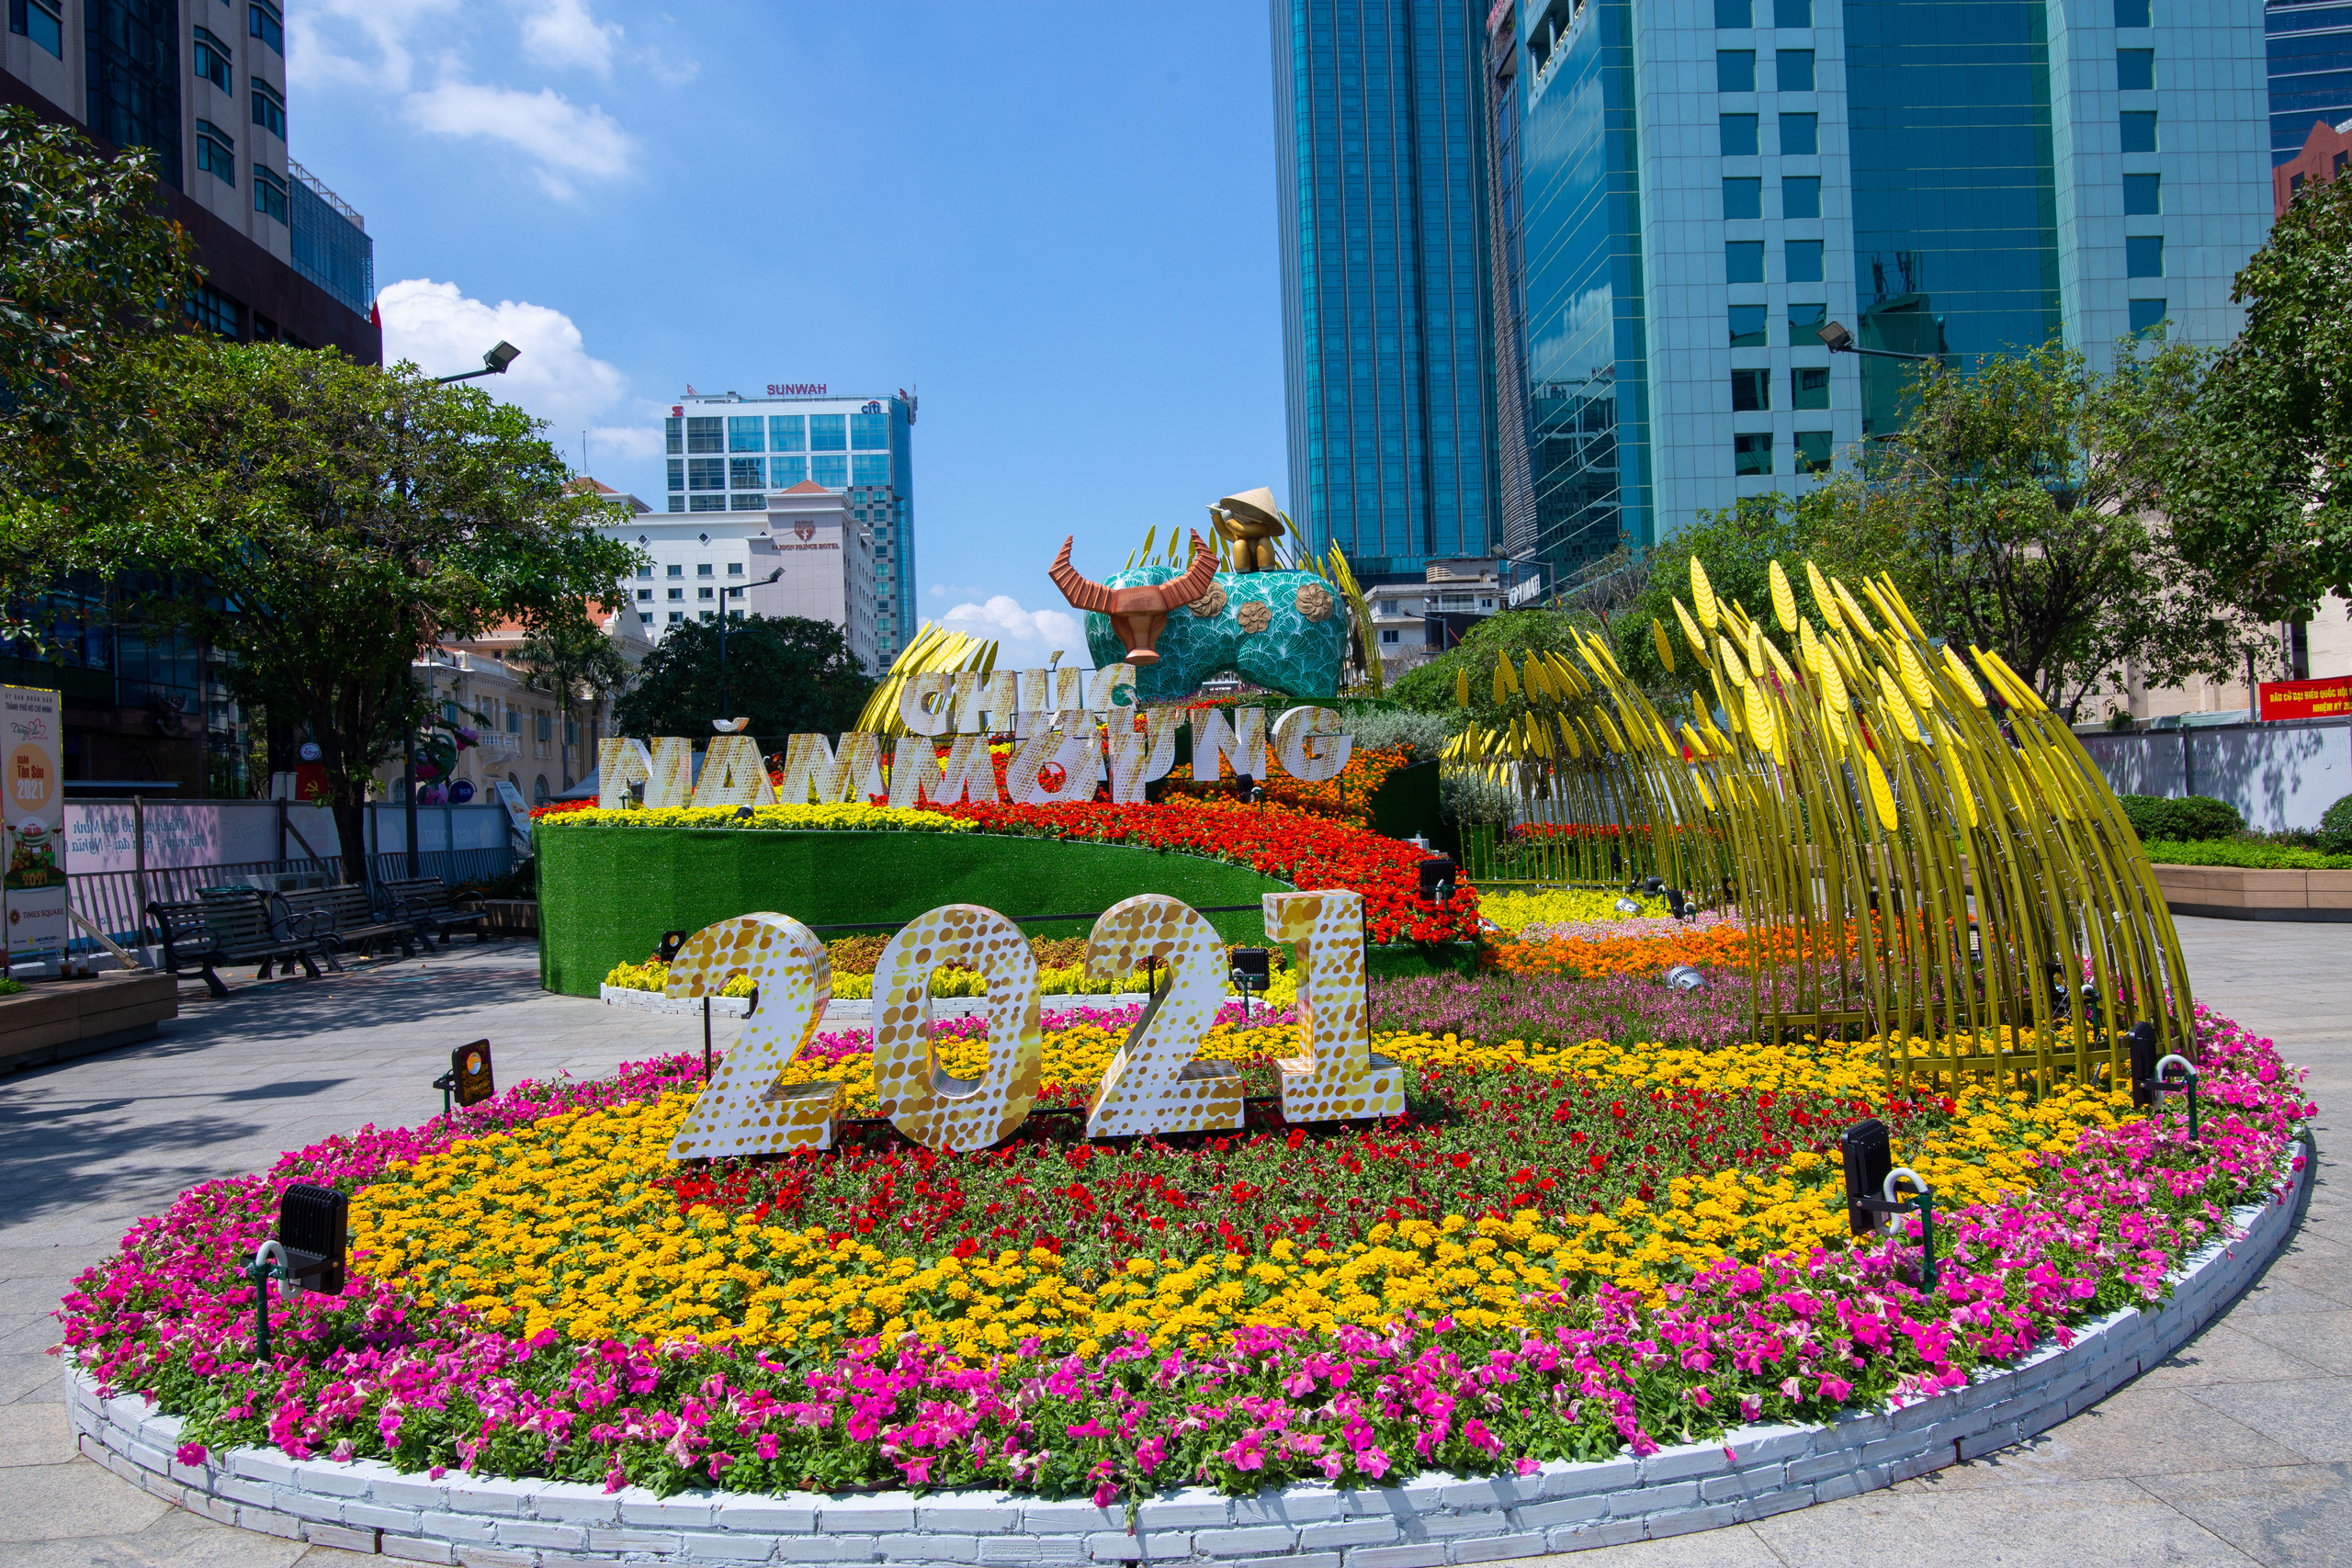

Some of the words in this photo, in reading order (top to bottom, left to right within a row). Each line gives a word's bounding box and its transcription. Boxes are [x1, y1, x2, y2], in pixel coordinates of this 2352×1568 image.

[767, 384, 827, 395] SUNWAH
[861, 400, 881, 414] citi
[899, 650, 1136, 736] CHÚC
[2320, 687, 2336, 699] QUỐC
[2337, 686, 2347, 698] HỘI
[6, 702, 18, 711] THÀNH
[19, 703, 28, 712] PHỐ
[28, 703, 34, 712] HỒ
[2312, 702, 2333, 713] NHIỆM
[17, 755, 29, 764] XUÂN
[598, 716, 889, 809] NĂM
[888, 709, 1146, 805] MỚI
[17, 765, 29, 779] Tân
[31, 765, 44, 779] Sửu
[17, 779, 43, 799] 2021
[22, 872, 48, 886] 2021
[23, 909, 40, 919] TIMES
[41, 908, 64, 918] SQUARE
[665, 888, 1406, 1159] 2021
